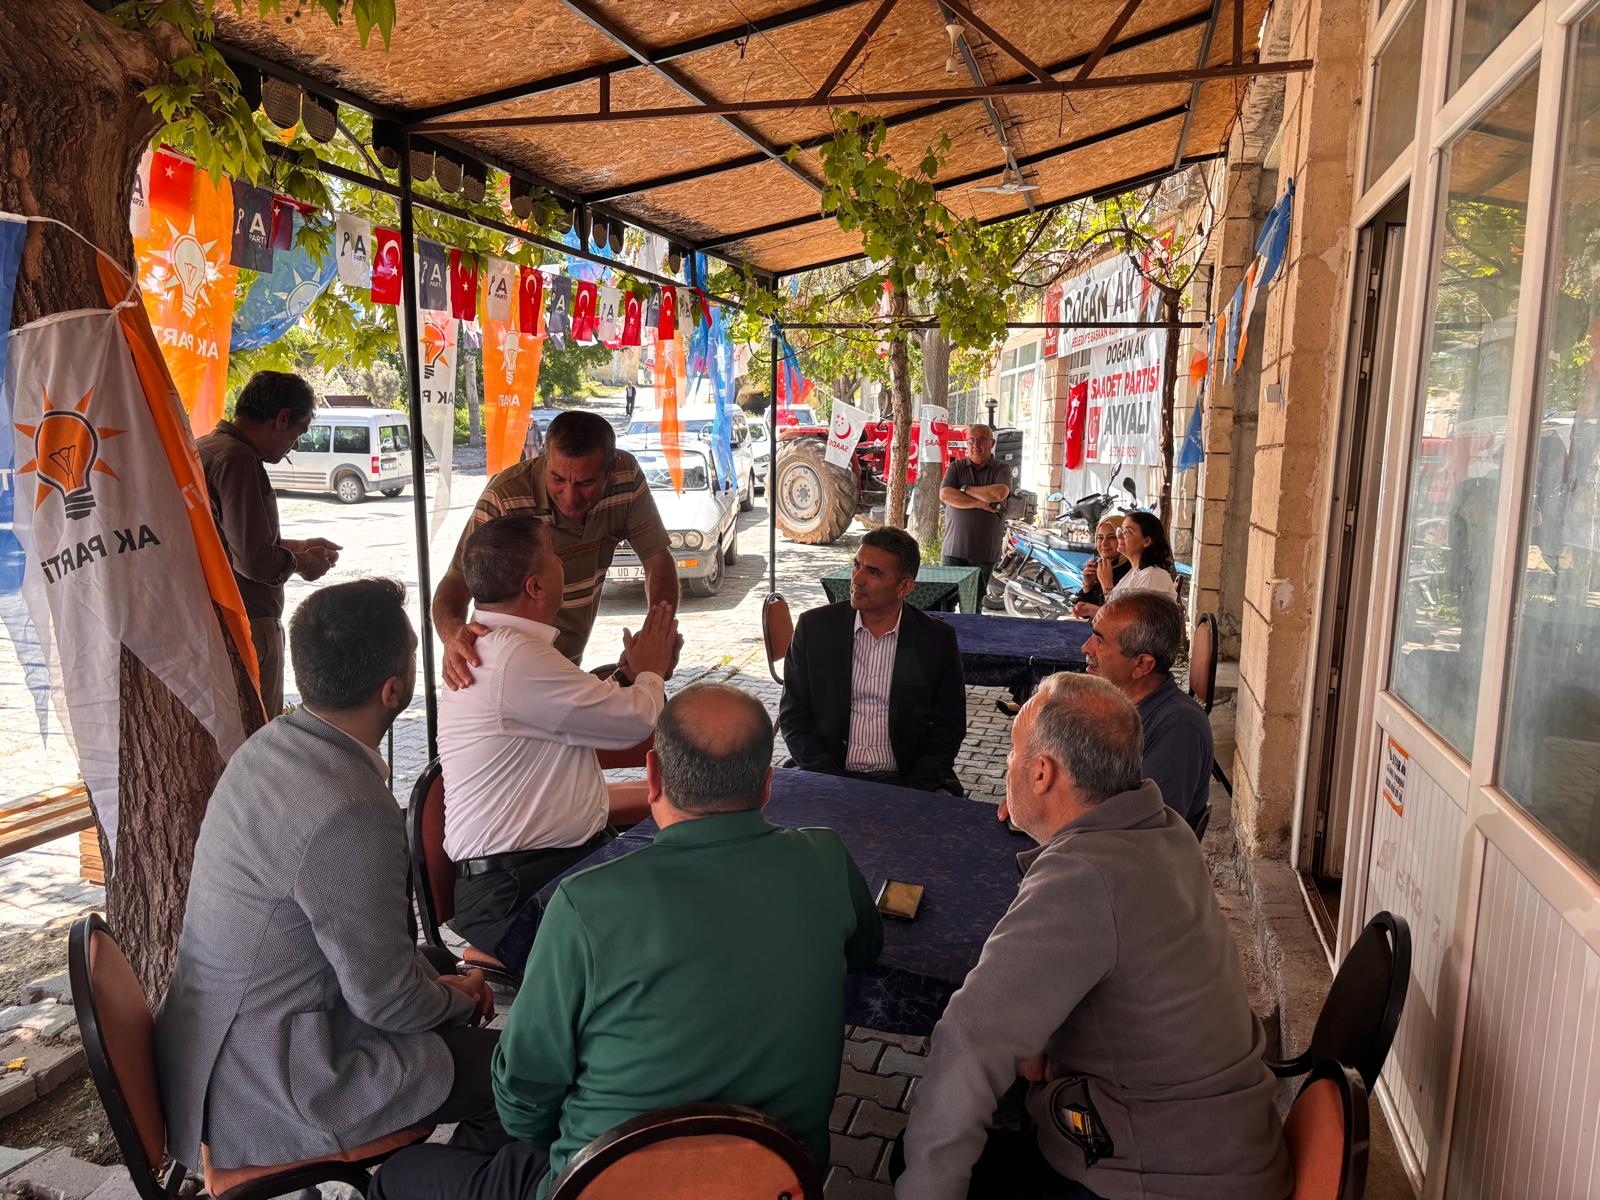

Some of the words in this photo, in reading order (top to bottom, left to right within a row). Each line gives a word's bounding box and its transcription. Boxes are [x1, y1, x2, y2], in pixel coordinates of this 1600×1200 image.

[249, 213, 266, 236] A
[354, 235, 366, 255] A
[431, 263, 442, 281] A
[495, 278, 508, 294] A
[556, 295, 565, 311] A
[1062, 277, 1112, 334] DOĞAN
[1113, 266, 1135, 316] AK
[607, 304, 614, 318] A
[1106, 338, 1134, 365] DOĞAN
[1134, 334, 1147, 358] AK
[1091, 373, 1122, 400] SAADET
[1104, 401, 1151, 435] AYVALI
